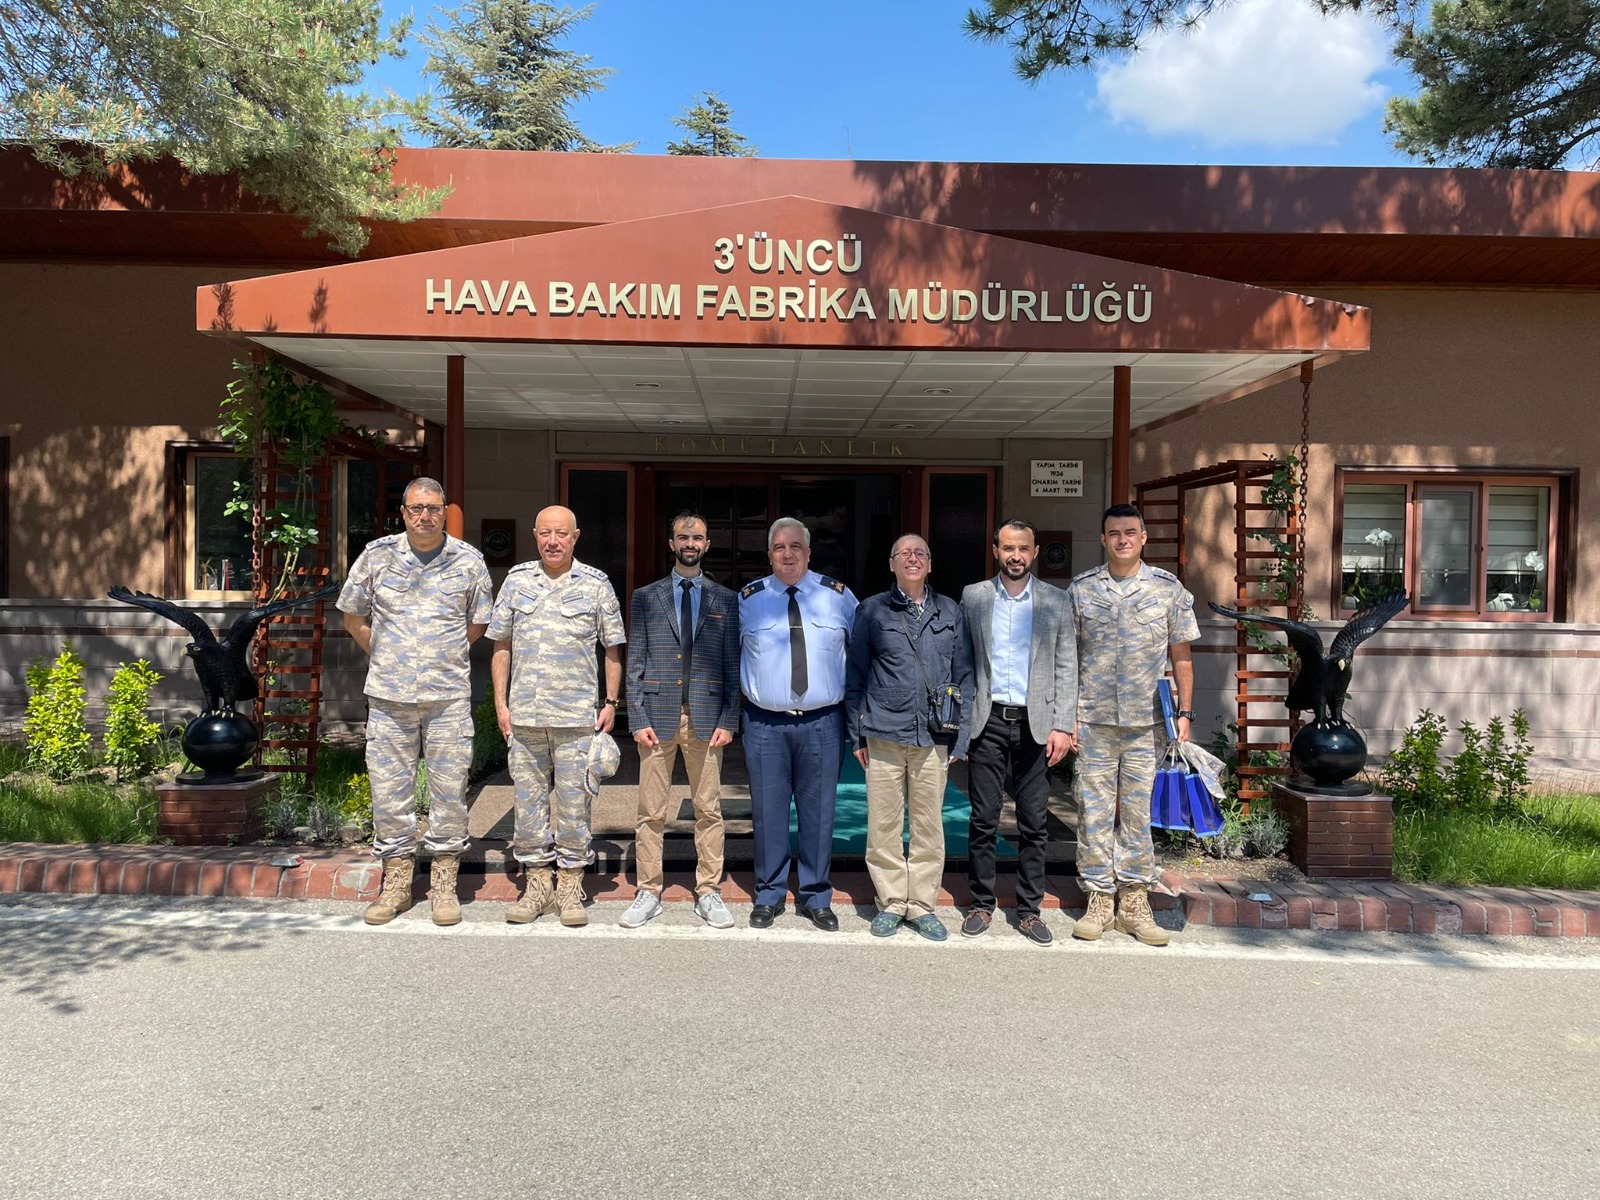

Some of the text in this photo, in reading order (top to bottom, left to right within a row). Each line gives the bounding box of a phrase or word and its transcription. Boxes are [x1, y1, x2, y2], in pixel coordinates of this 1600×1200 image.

[714, 231, 862, 275] 3'ÜNCÜ
[426, 278, 1152, 323] HAVA BAKIM FABRİKA MÜDÜRLÜĞÜ
[653, 436, 903, 456] KOMUTANLIK
